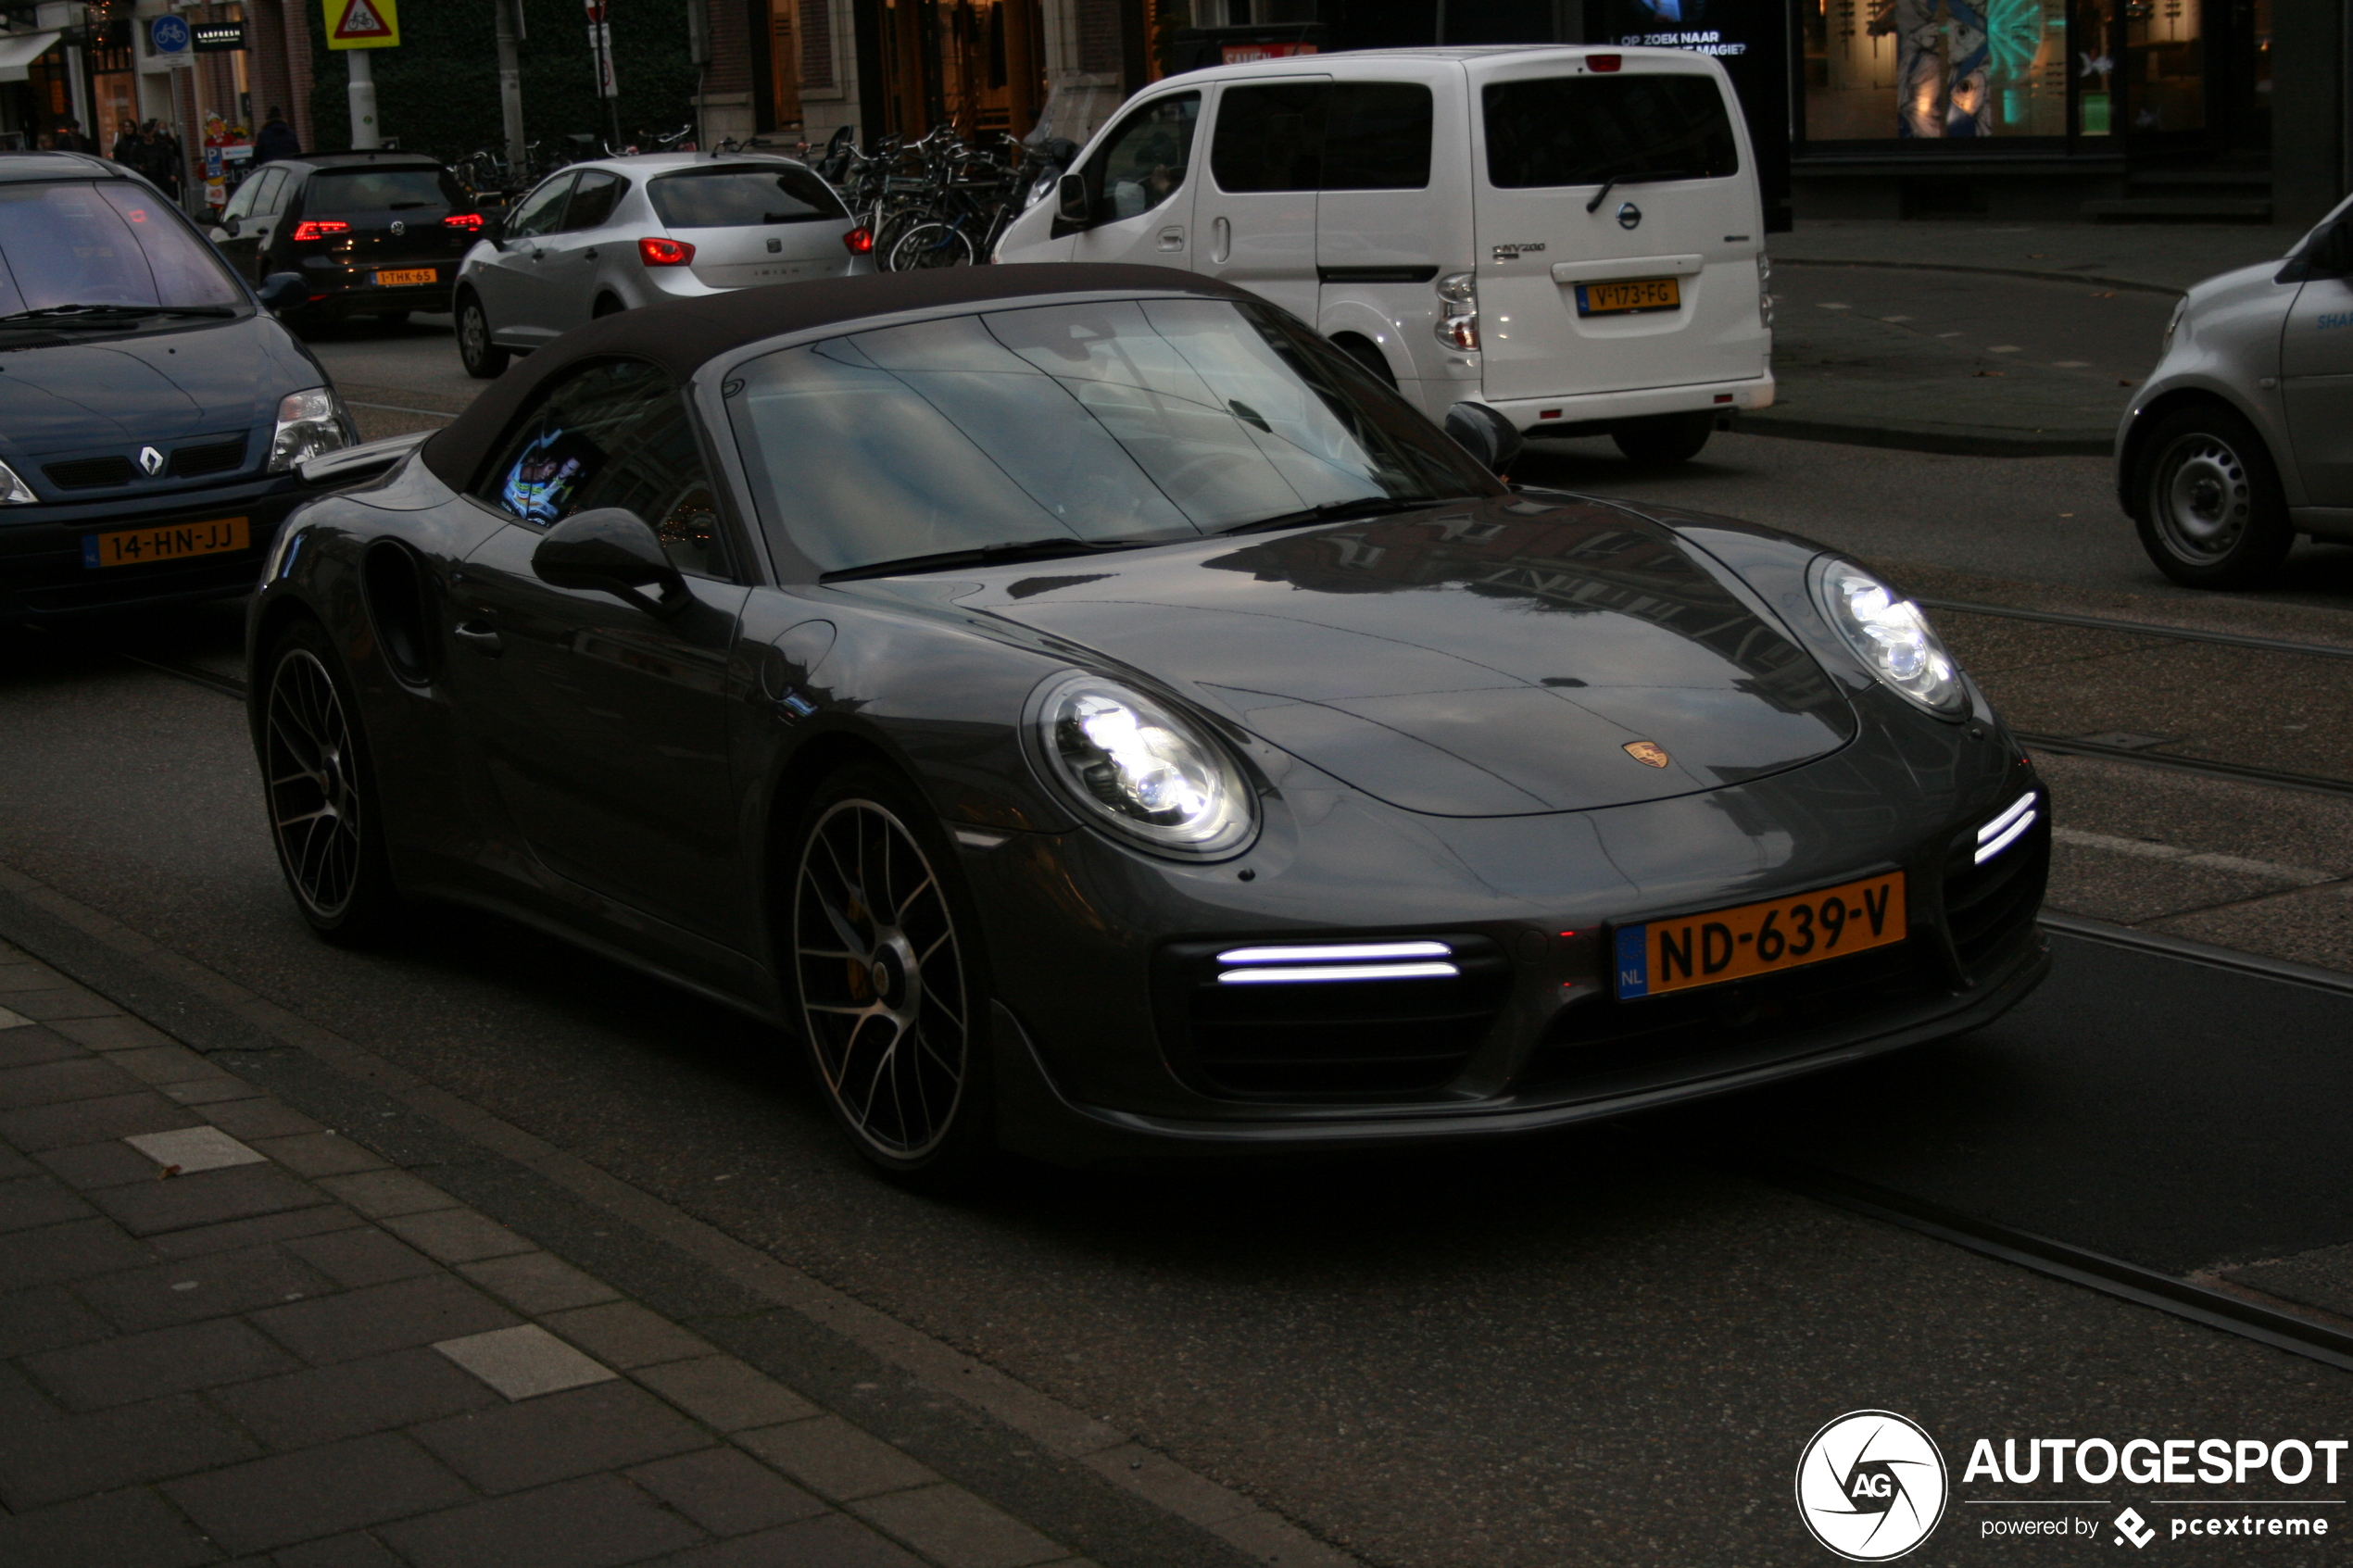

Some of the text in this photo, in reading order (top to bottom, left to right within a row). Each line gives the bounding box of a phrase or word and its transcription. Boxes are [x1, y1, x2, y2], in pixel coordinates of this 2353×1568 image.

[1621, 35, 1640, 46] OP
[1643, 33, 1679, 45] ZOEK
[1680, 31, 1719, 44] NAAR
[1696, 44, 1746, 56] MAGIE?
[381, 270, 431, 283] 1-THK-65
[112, 522, 233, 560] 14-HN-JJ
[1660, 884, 1890, 982] ND-639-V
[1621, 969, 1643, 986] NL
